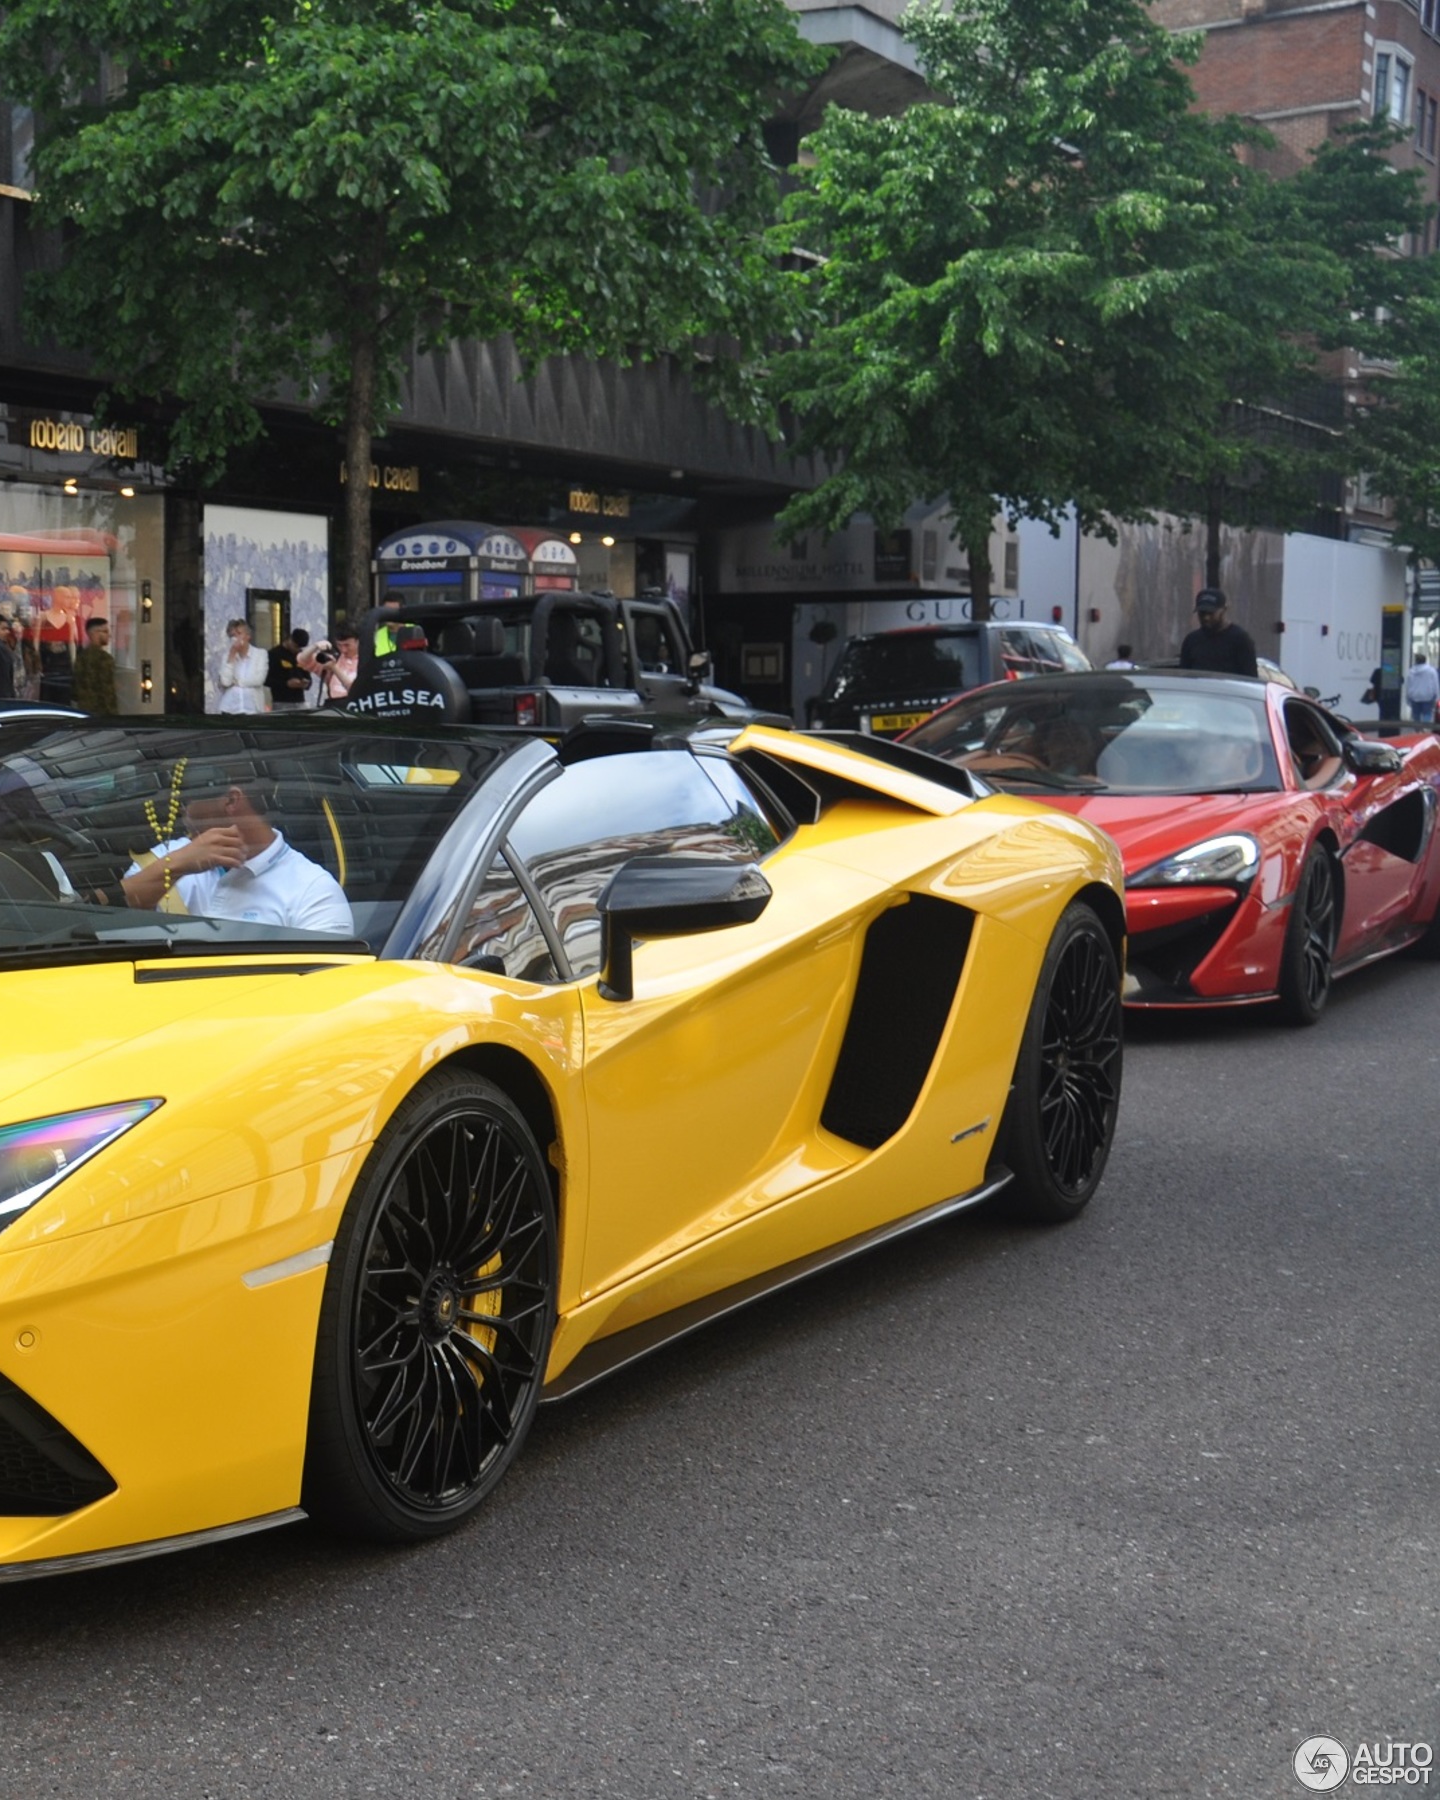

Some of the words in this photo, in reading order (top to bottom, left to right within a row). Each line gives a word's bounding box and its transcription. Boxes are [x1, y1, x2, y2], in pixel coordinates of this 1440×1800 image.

[31, 417, 84, 452] roberto
[91, 427, 138, 458] cavalli
[822, 561, 864, 575] HOTEL
[346, 689, 445, 712] CHELSEA
[903, 697, 948, 706] ROVER
[447, 1086, 483, 1099] ZERO
